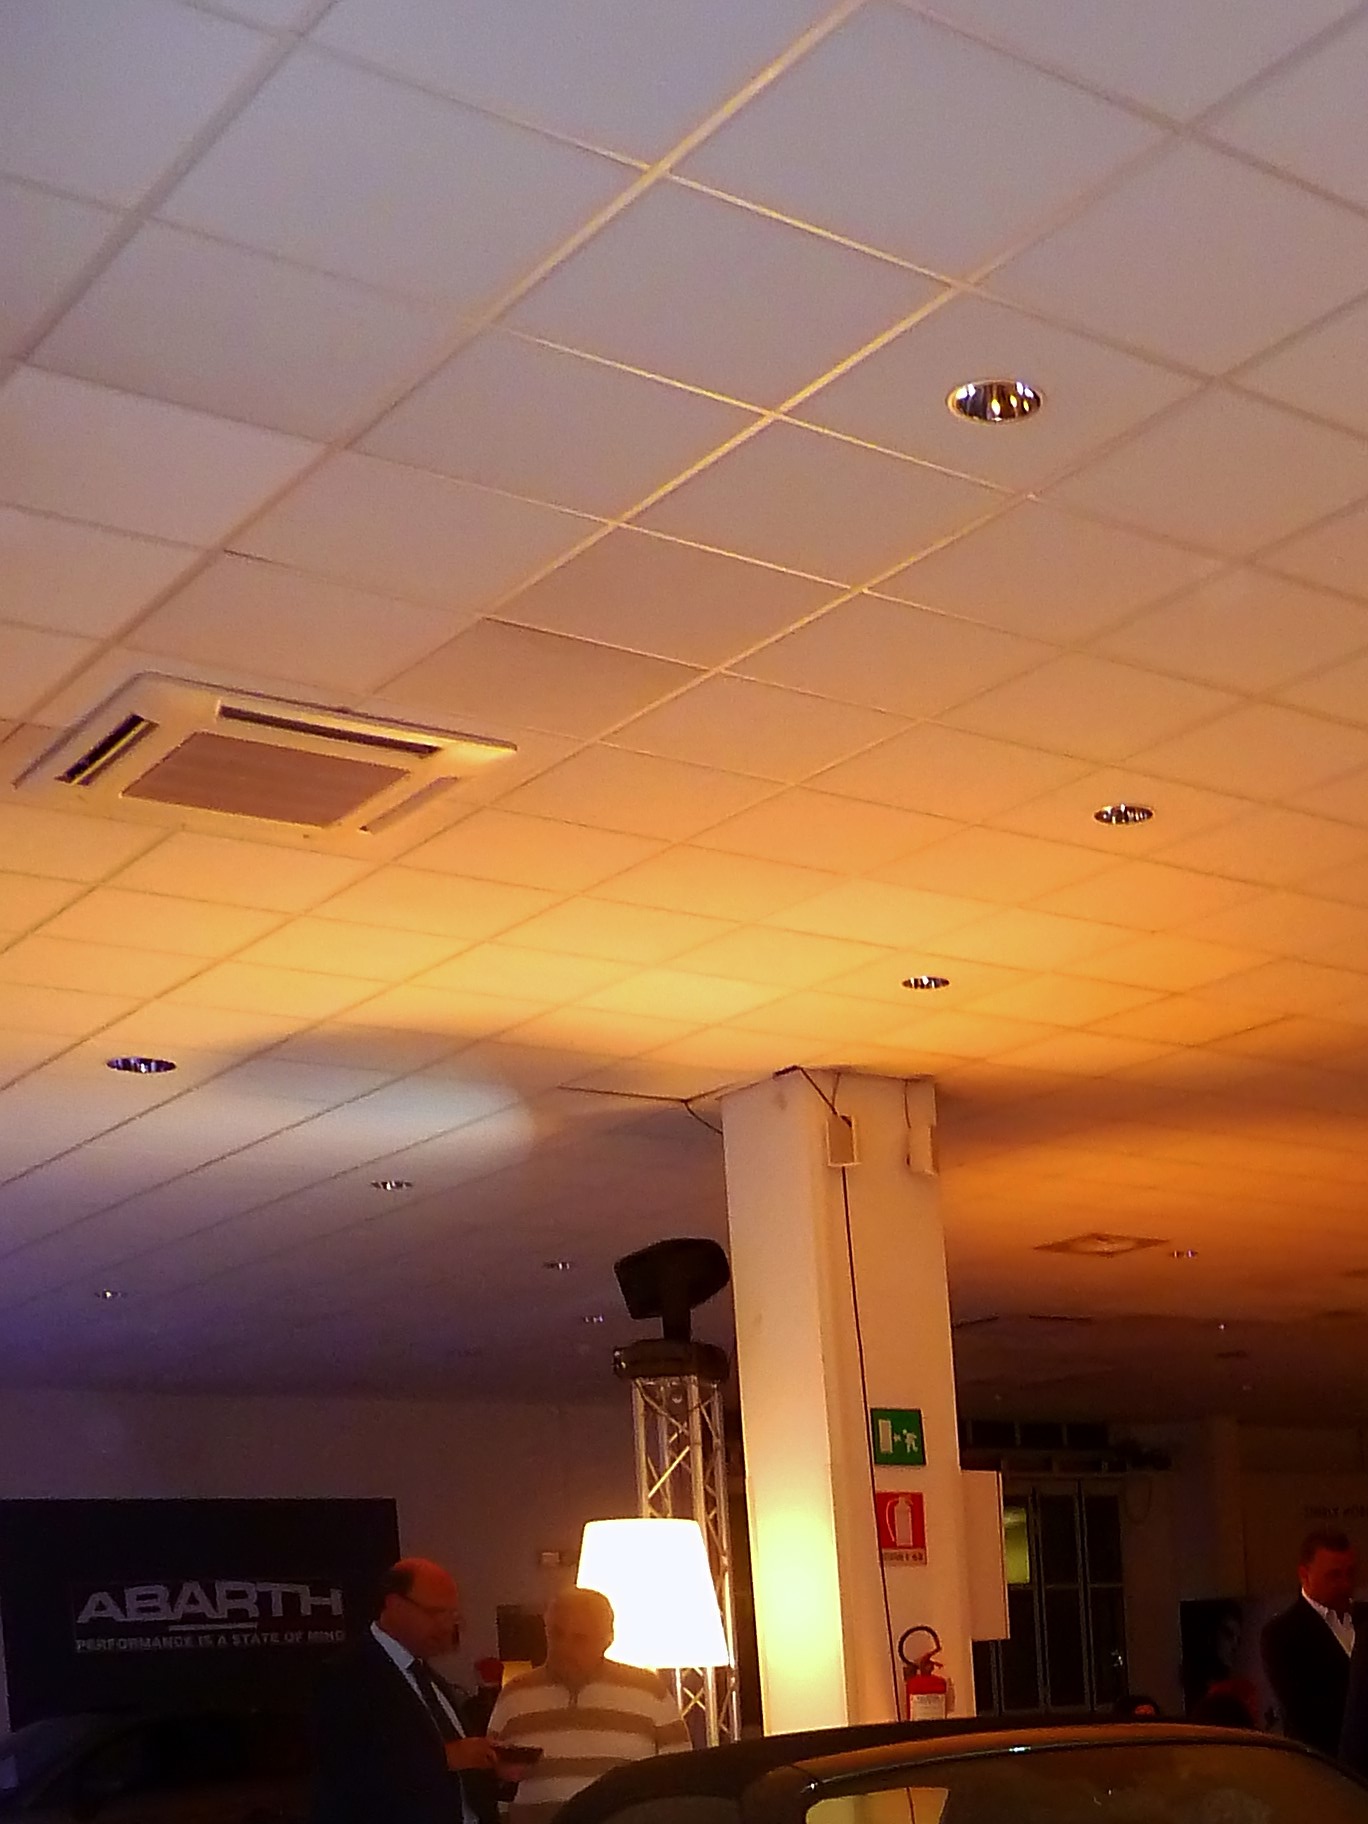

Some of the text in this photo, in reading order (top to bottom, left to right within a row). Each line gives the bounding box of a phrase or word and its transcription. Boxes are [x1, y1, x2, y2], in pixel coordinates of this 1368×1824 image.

[76, 1580, 345, 1624] ABARTH
[75, 1635, 193, 1653] PERFORMANCE
[197, 1634, 213, 1648] IS
[217, 1633, 228, 1647] A
[231, 1631, 280, 1648] STATE
[284, 1631, 303, 1643] OF
